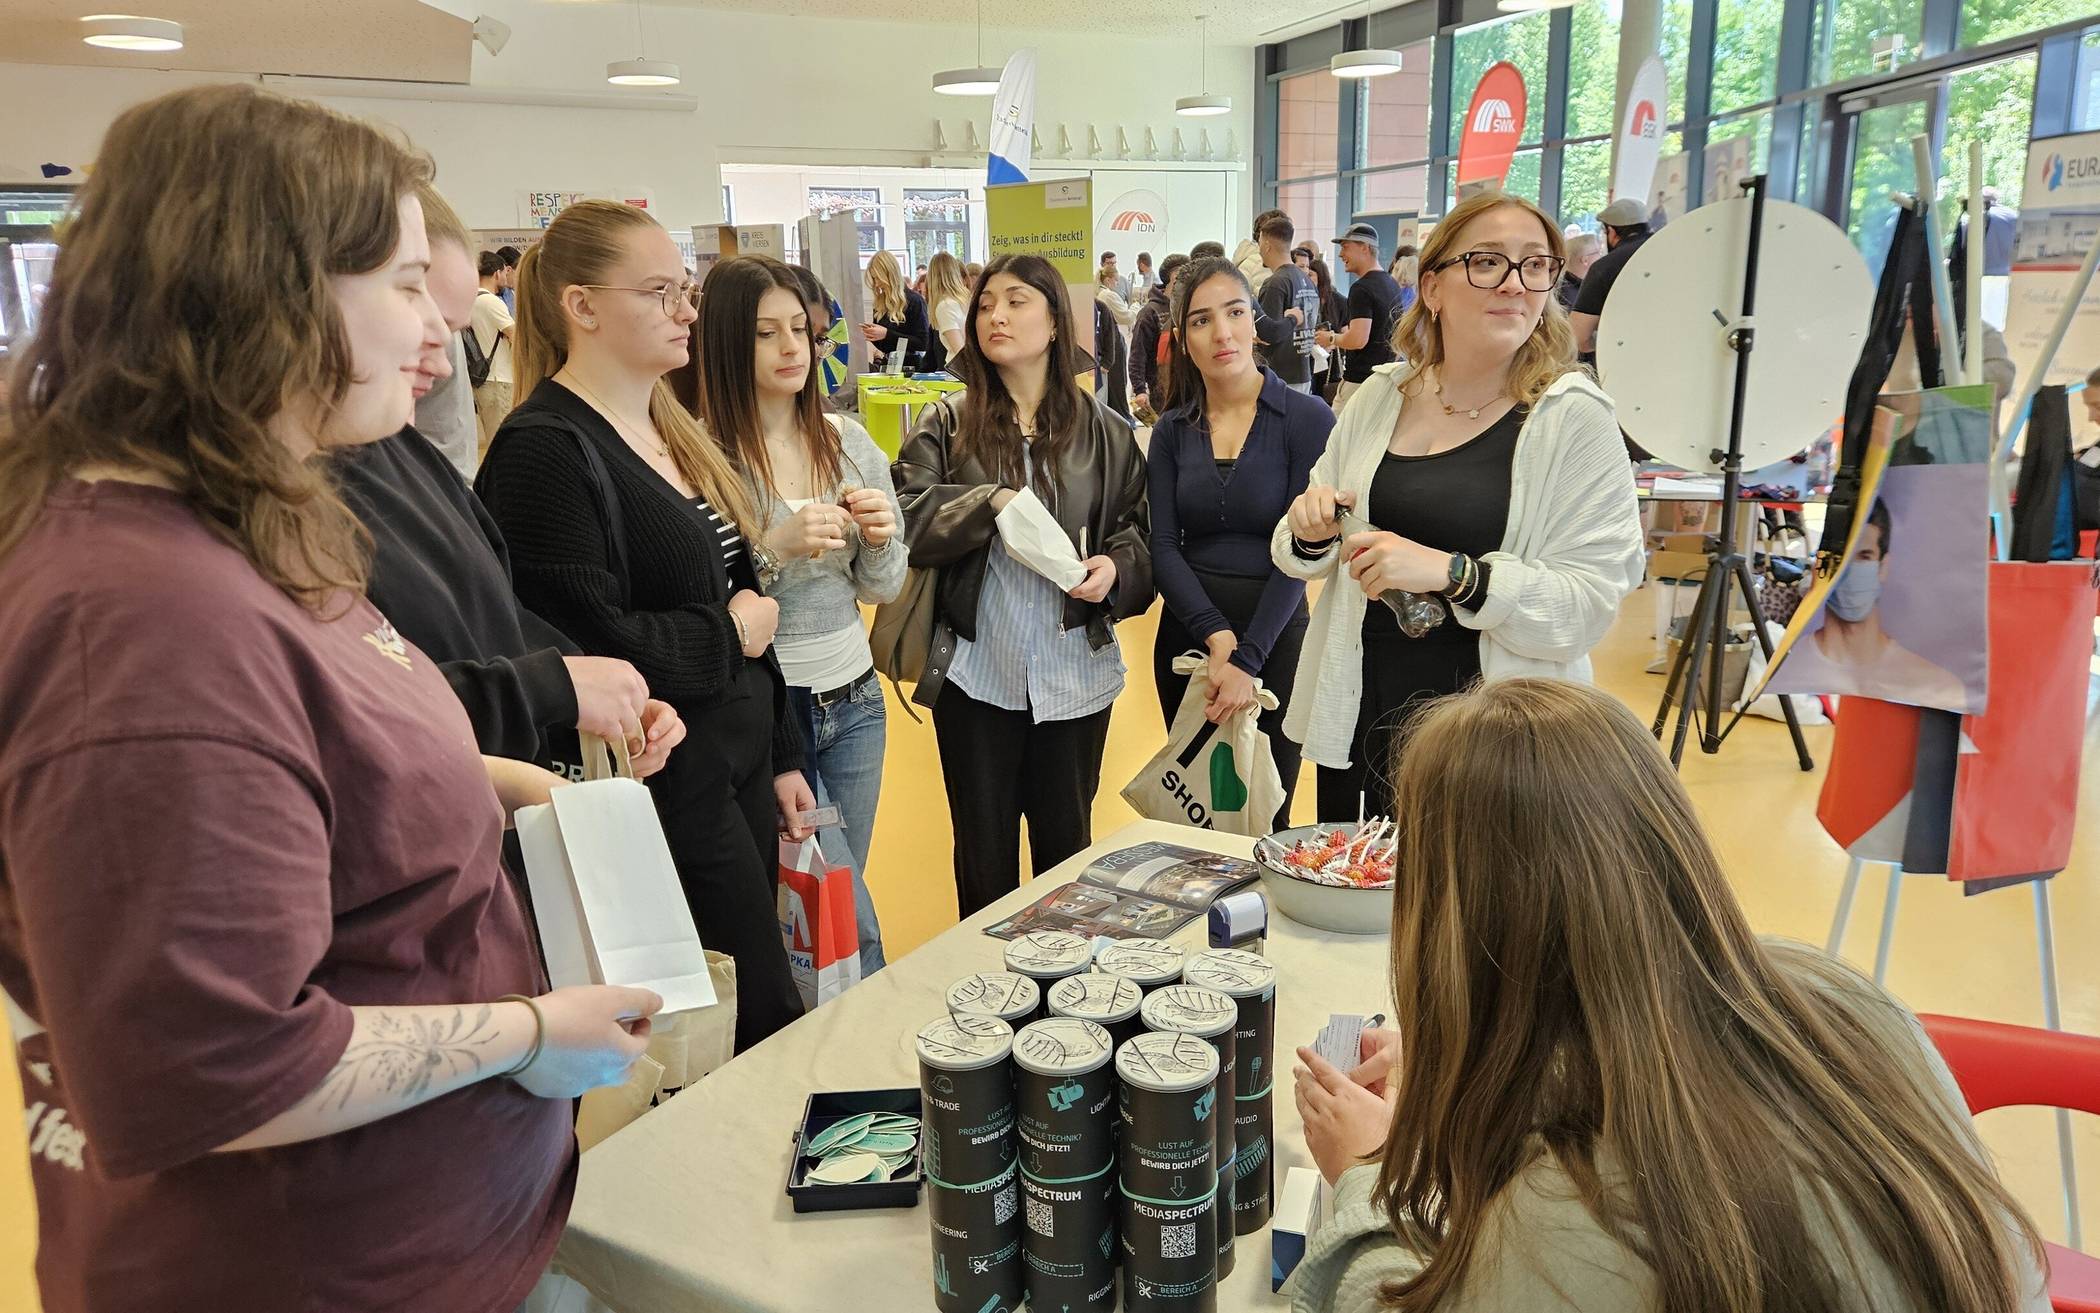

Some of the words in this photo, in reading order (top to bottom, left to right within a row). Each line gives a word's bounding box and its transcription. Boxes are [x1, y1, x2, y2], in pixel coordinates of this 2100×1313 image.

[1493, 118, 1516, 133] SWK
[2067, 157, 2100, 179] EUR
[1137, 223, 1155, 232] IDN
[991, 235, 1011, 247] Zeig,
[1013, 236, 1029, 245] was
[1031, 233, 1039, 243] in
[1041, 231, 1053, 243] dir
[1054, 230, 1083, 242] steckt!
[935, 1099, 960, 1112] TRADE
[1234, 1114, 1258, 1125] AUDIO
[1047, 1133, 1082, 1143] TECHNIK?
[1046, 1144, 1070, 1152] JETZT!
[1158, 1142, 1177, 1150] LUST
[1179, 1139, 1194, 1149] AUF
[1141, 1158, 1171, 1171] BEWIRB
[1172, 1161, 1191, 1170] DICH
[1191, 1152, 1210, 1168] JETZT!
[1133, 1194, 1216, 1221] MEDIASPECTRUM
[1160, 1285, 1192, 1295] BEREICH
[1192, 1284, 1198, 1292] A
